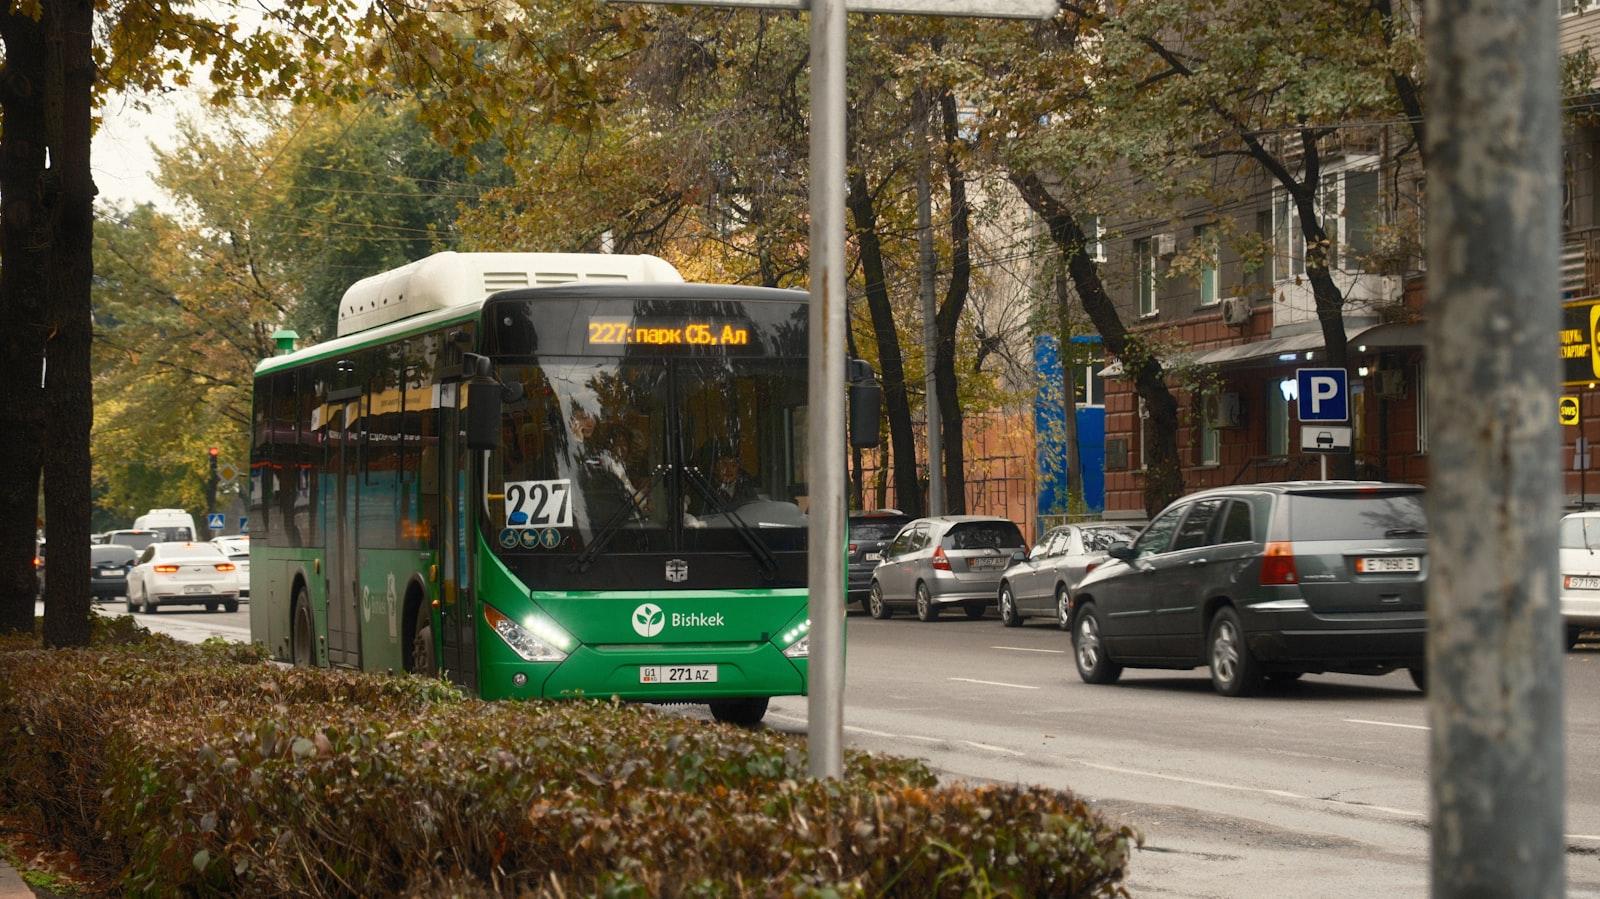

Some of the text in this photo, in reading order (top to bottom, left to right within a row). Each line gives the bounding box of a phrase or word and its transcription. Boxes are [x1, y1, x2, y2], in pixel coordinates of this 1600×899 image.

[589, 323, 632, 344] 227:
[636, 328, 681, 344] парк
[721, 324, 747, 344] Ал
[1311, 376, 1338, 413] P
[507, 483, 569, 525] 227
[671, 612, 725, 627] Bishkek
[669, 668, 692, 681] 271
[695, 669, 709, 681] AZ
